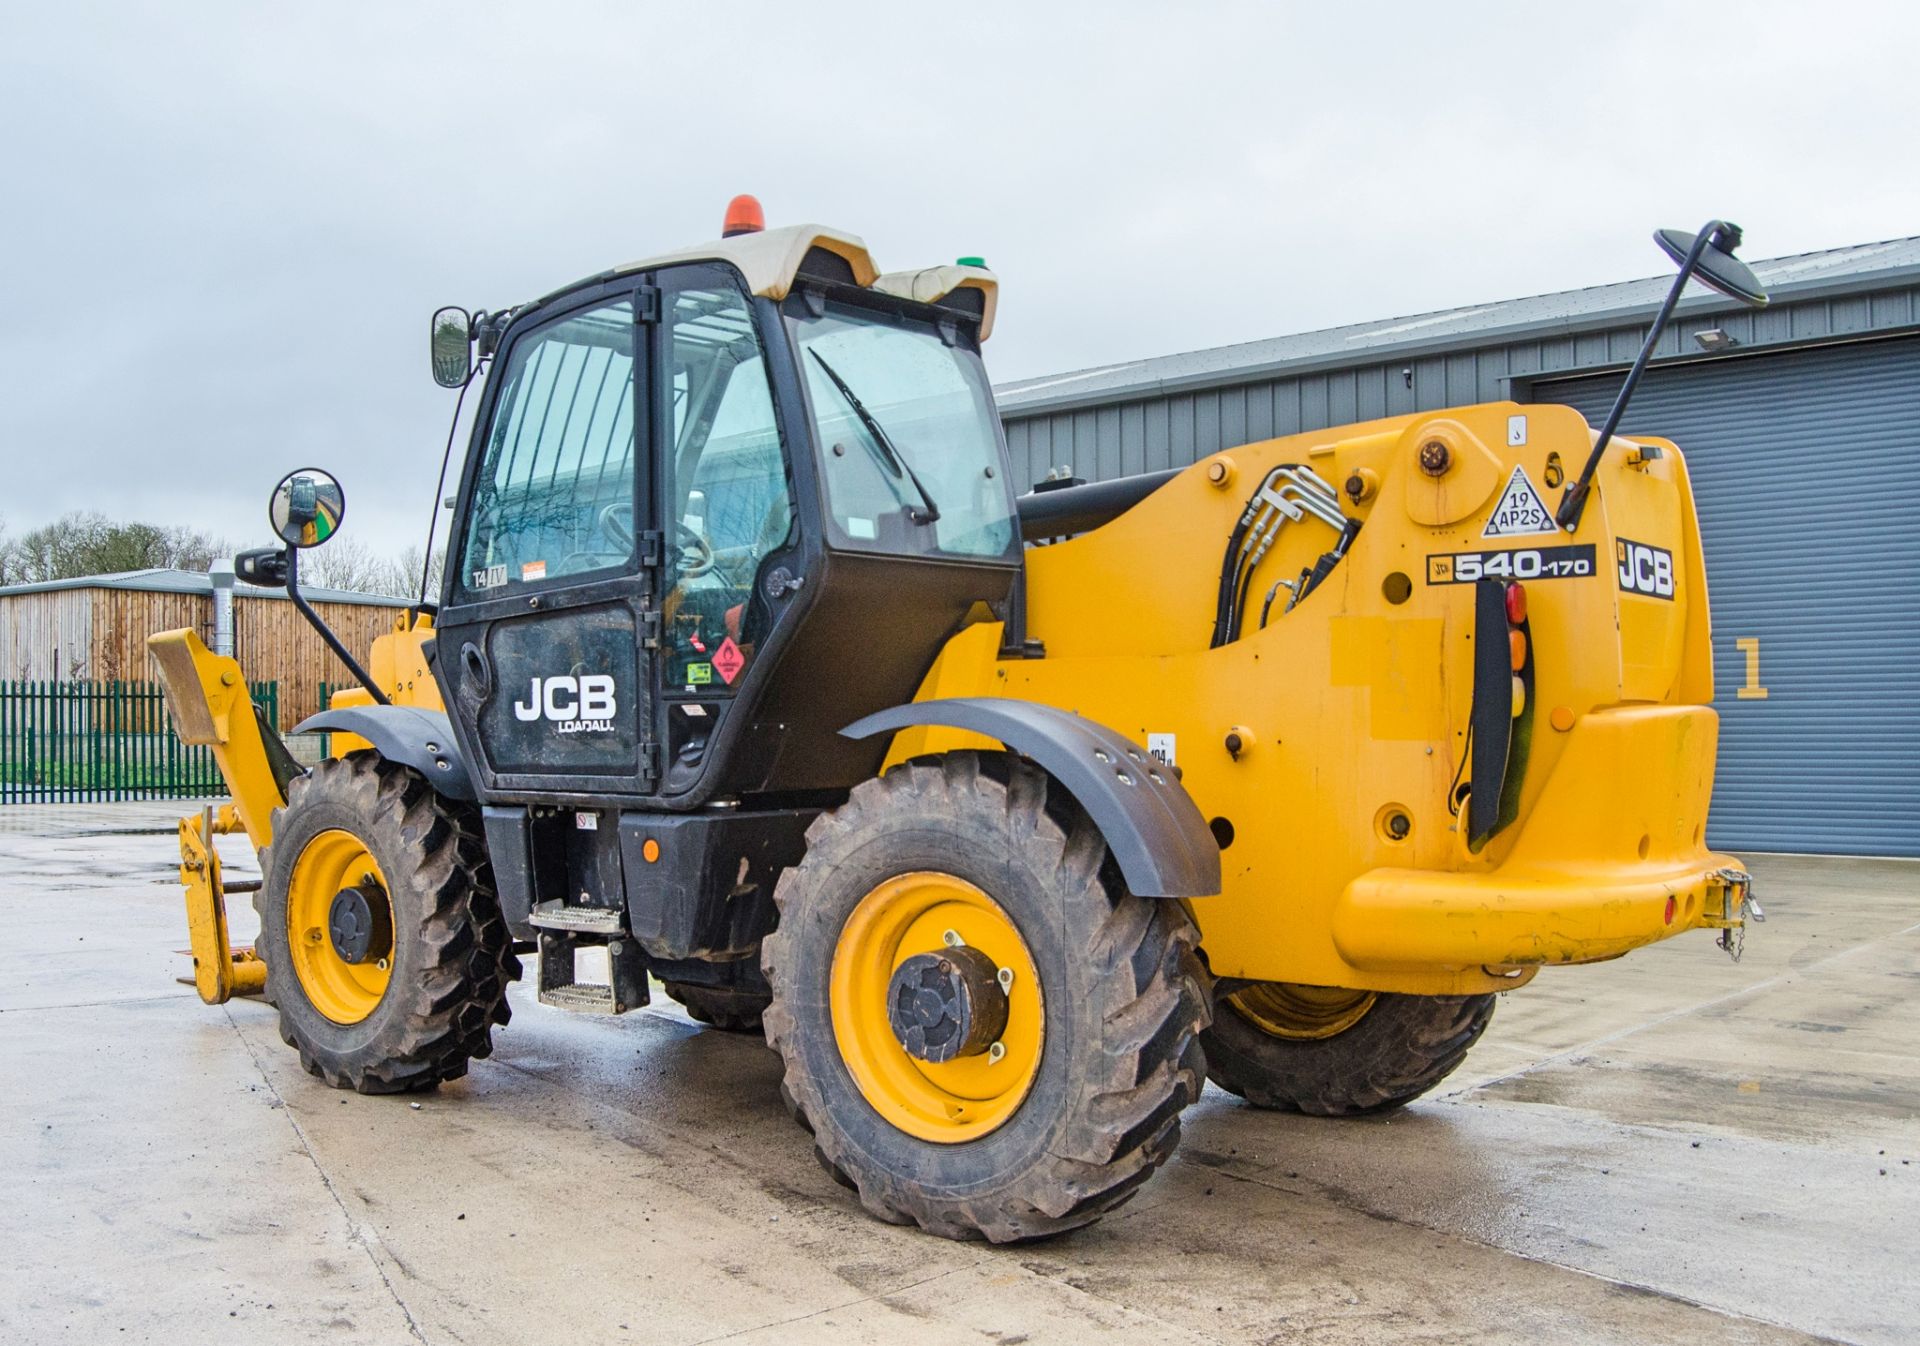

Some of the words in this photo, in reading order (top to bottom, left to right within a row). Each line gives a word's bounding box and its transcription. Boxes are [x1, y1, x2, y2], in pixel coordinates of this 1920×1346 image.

[1510, 492, 1528, 508] 19
[1500, 509, 1540, 526] AP2S
[472, 571, 487, 588] T4
[1455, 550, 1590, 581] 540-170
[1619, 543, 1673, 596] JCB
[1736, 638, 1768, 699] 1
[514, 675, 616, 721] JCB
